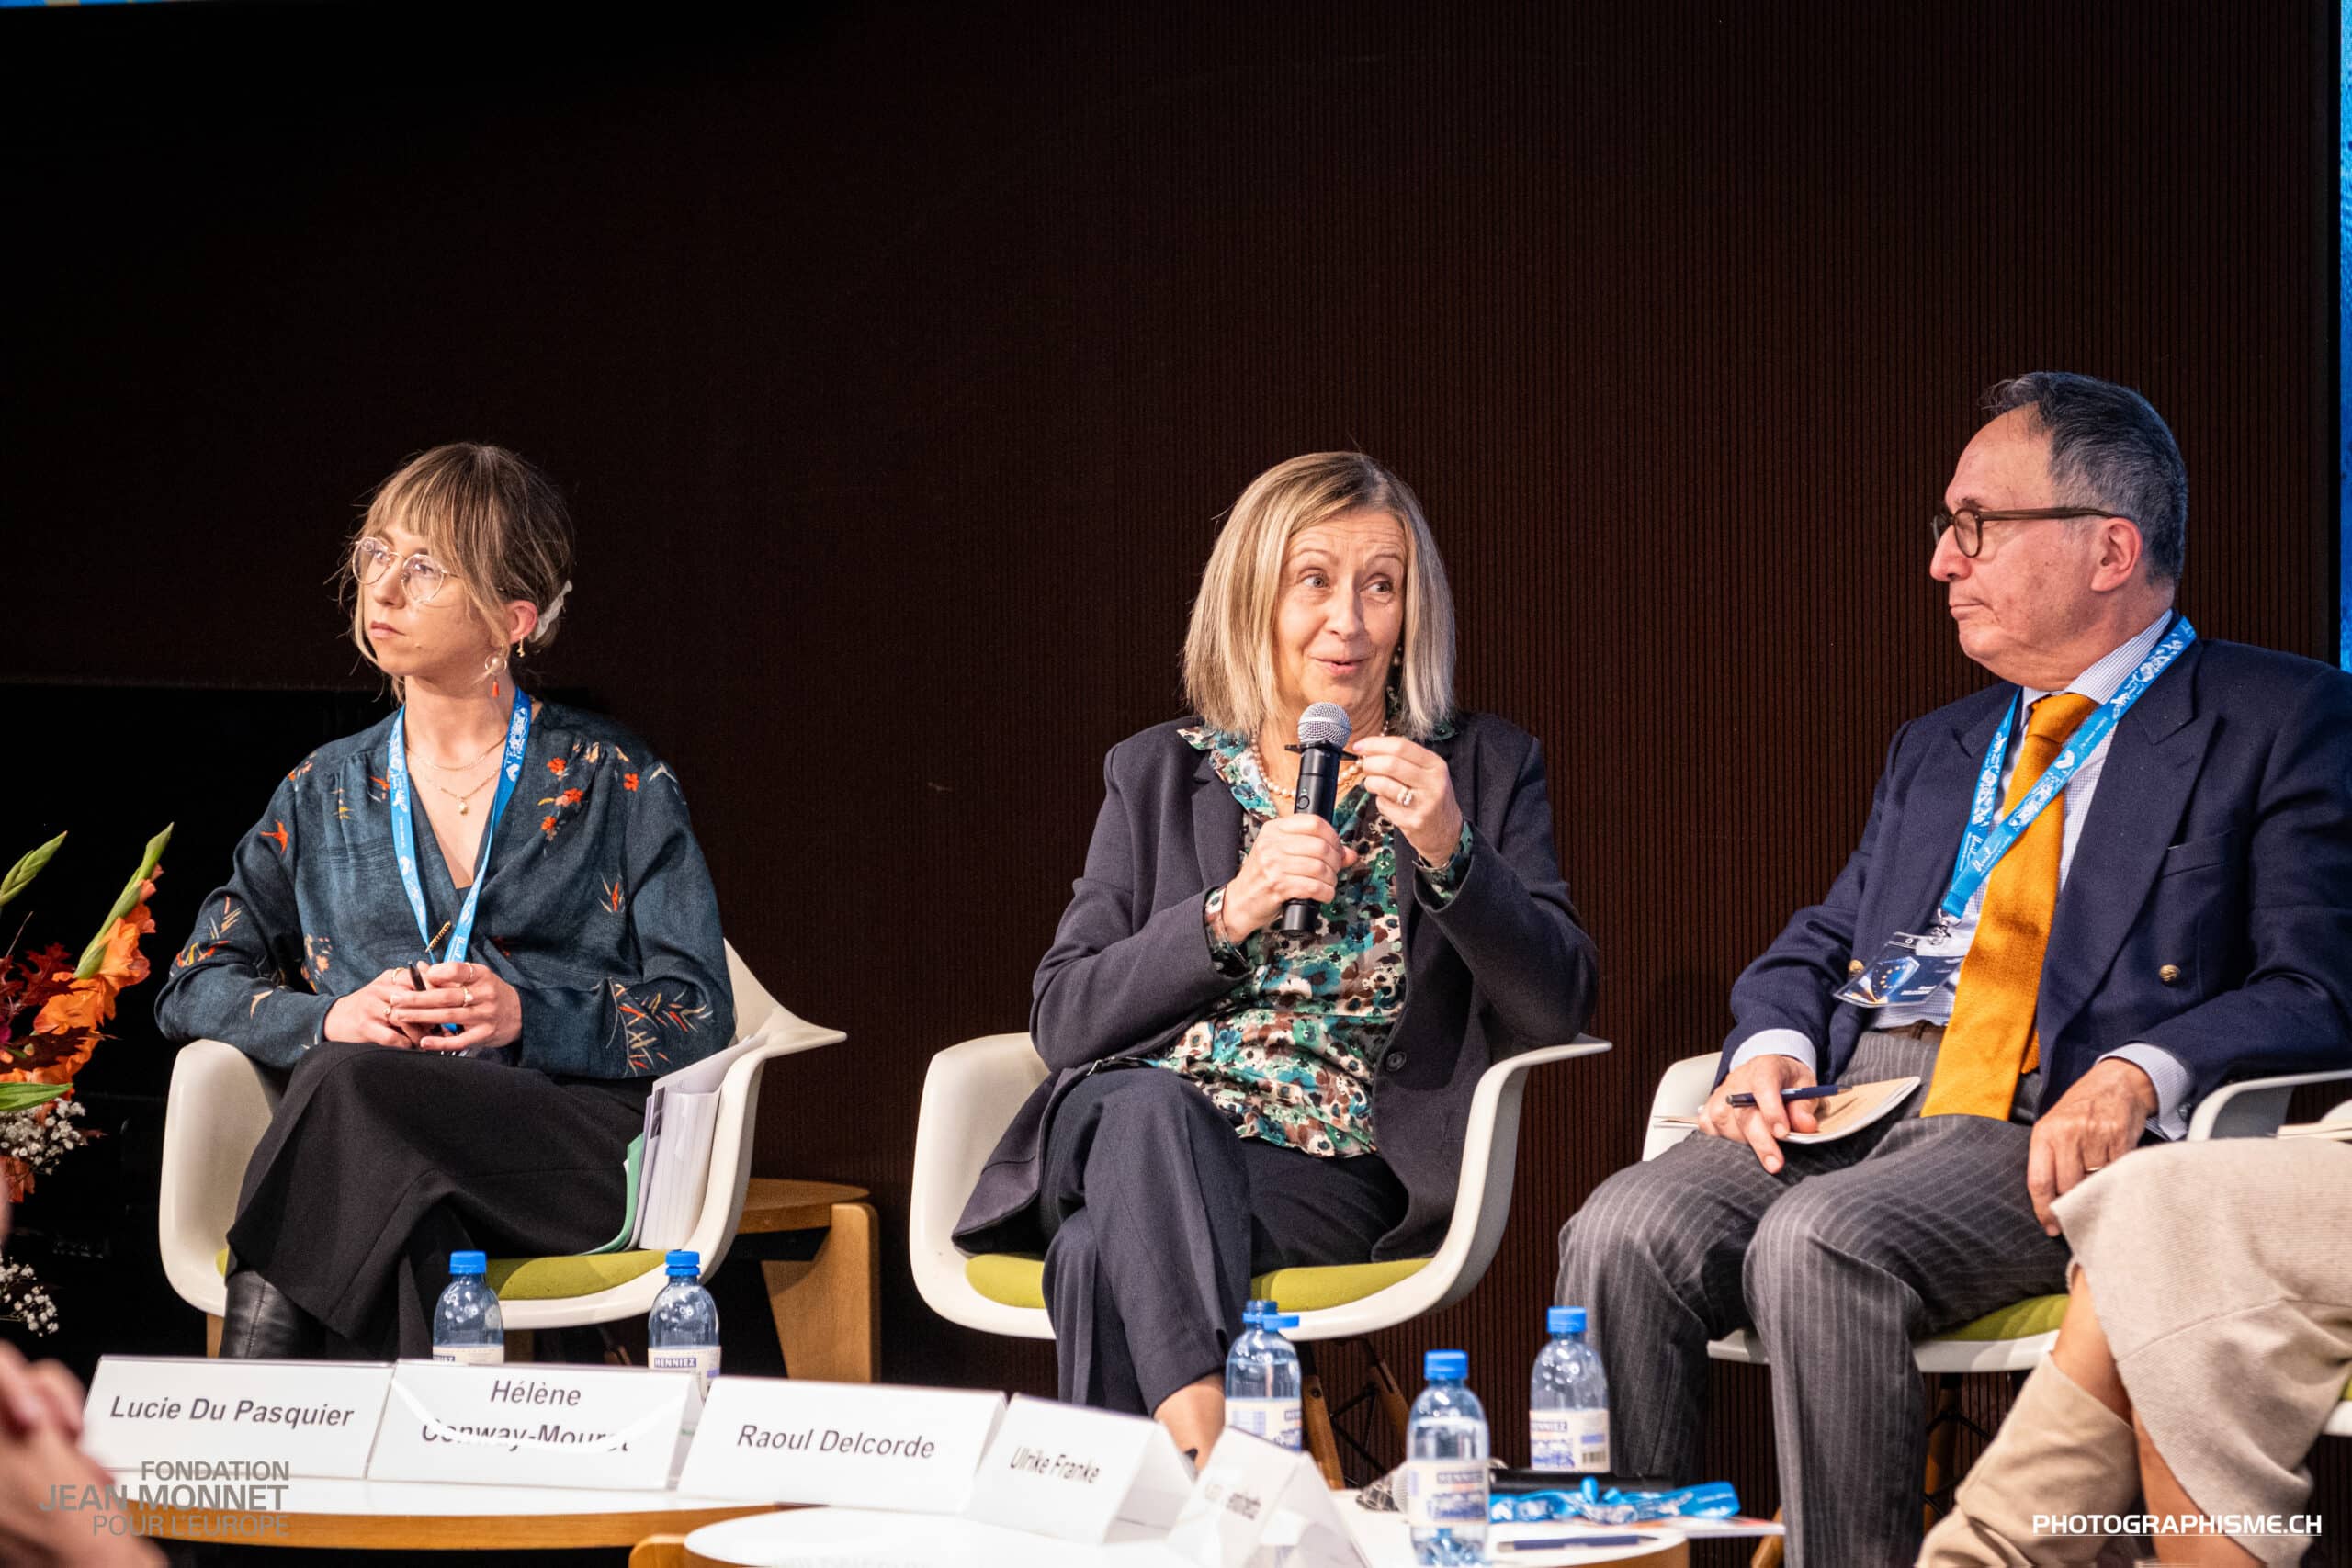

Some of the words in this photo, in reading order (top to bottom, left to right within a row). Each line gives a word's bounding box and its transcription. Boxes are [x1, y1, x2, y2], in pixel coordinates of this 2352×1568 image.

[490, 1380, 582, 1406] Hélène
[109, 1395, 181, 1419] Lucie
[189, 1397, 227, 1421] Du
[233, 1399, 355, 1429] Pasquier
[737, 1424, 814, 1450] Raoul
[819, 1429, 935, 1459] Delcorde
[1010, 1446, 1050, 1474] Ulrike
[1050, 1454, 1100, 1483] Franke
